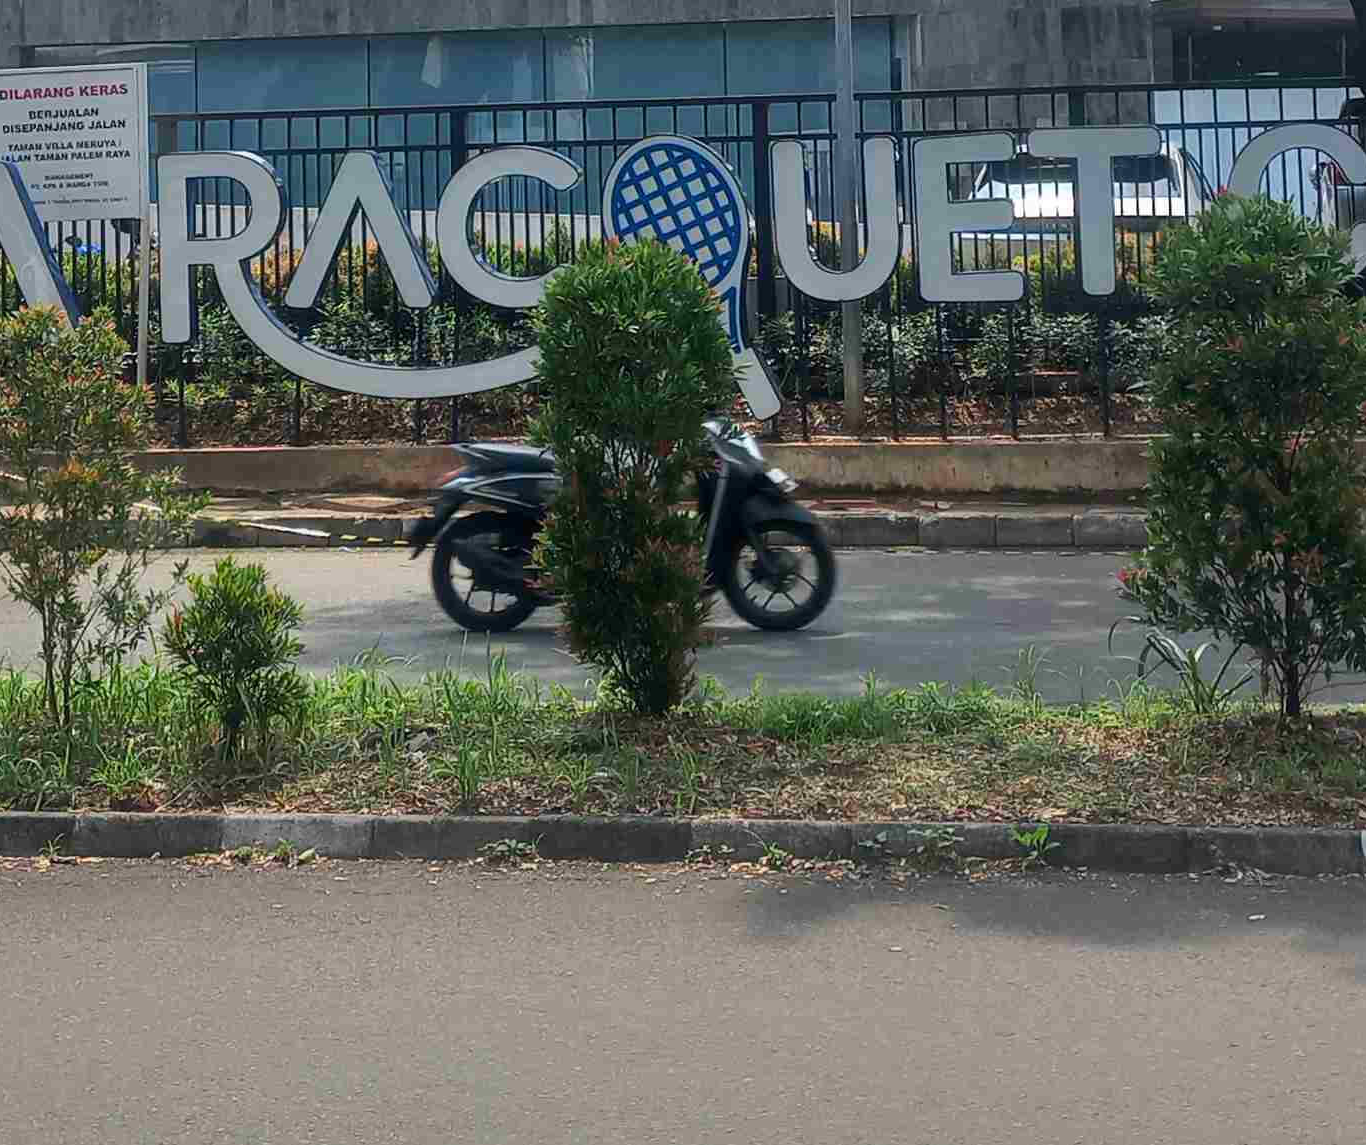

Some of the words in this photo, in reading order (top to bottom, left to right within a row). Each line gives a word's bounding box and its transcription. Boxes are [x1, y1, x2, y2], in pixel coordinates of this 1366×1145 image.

[79, 82, 129, 97] KERAS
[28, 107, 99, 120] BERJUALAN
[2, 123, 85, 135] DISEPANJANG
[88, 118, 127, 131] JALAN
[45, 141, 75, 151] VILLA
